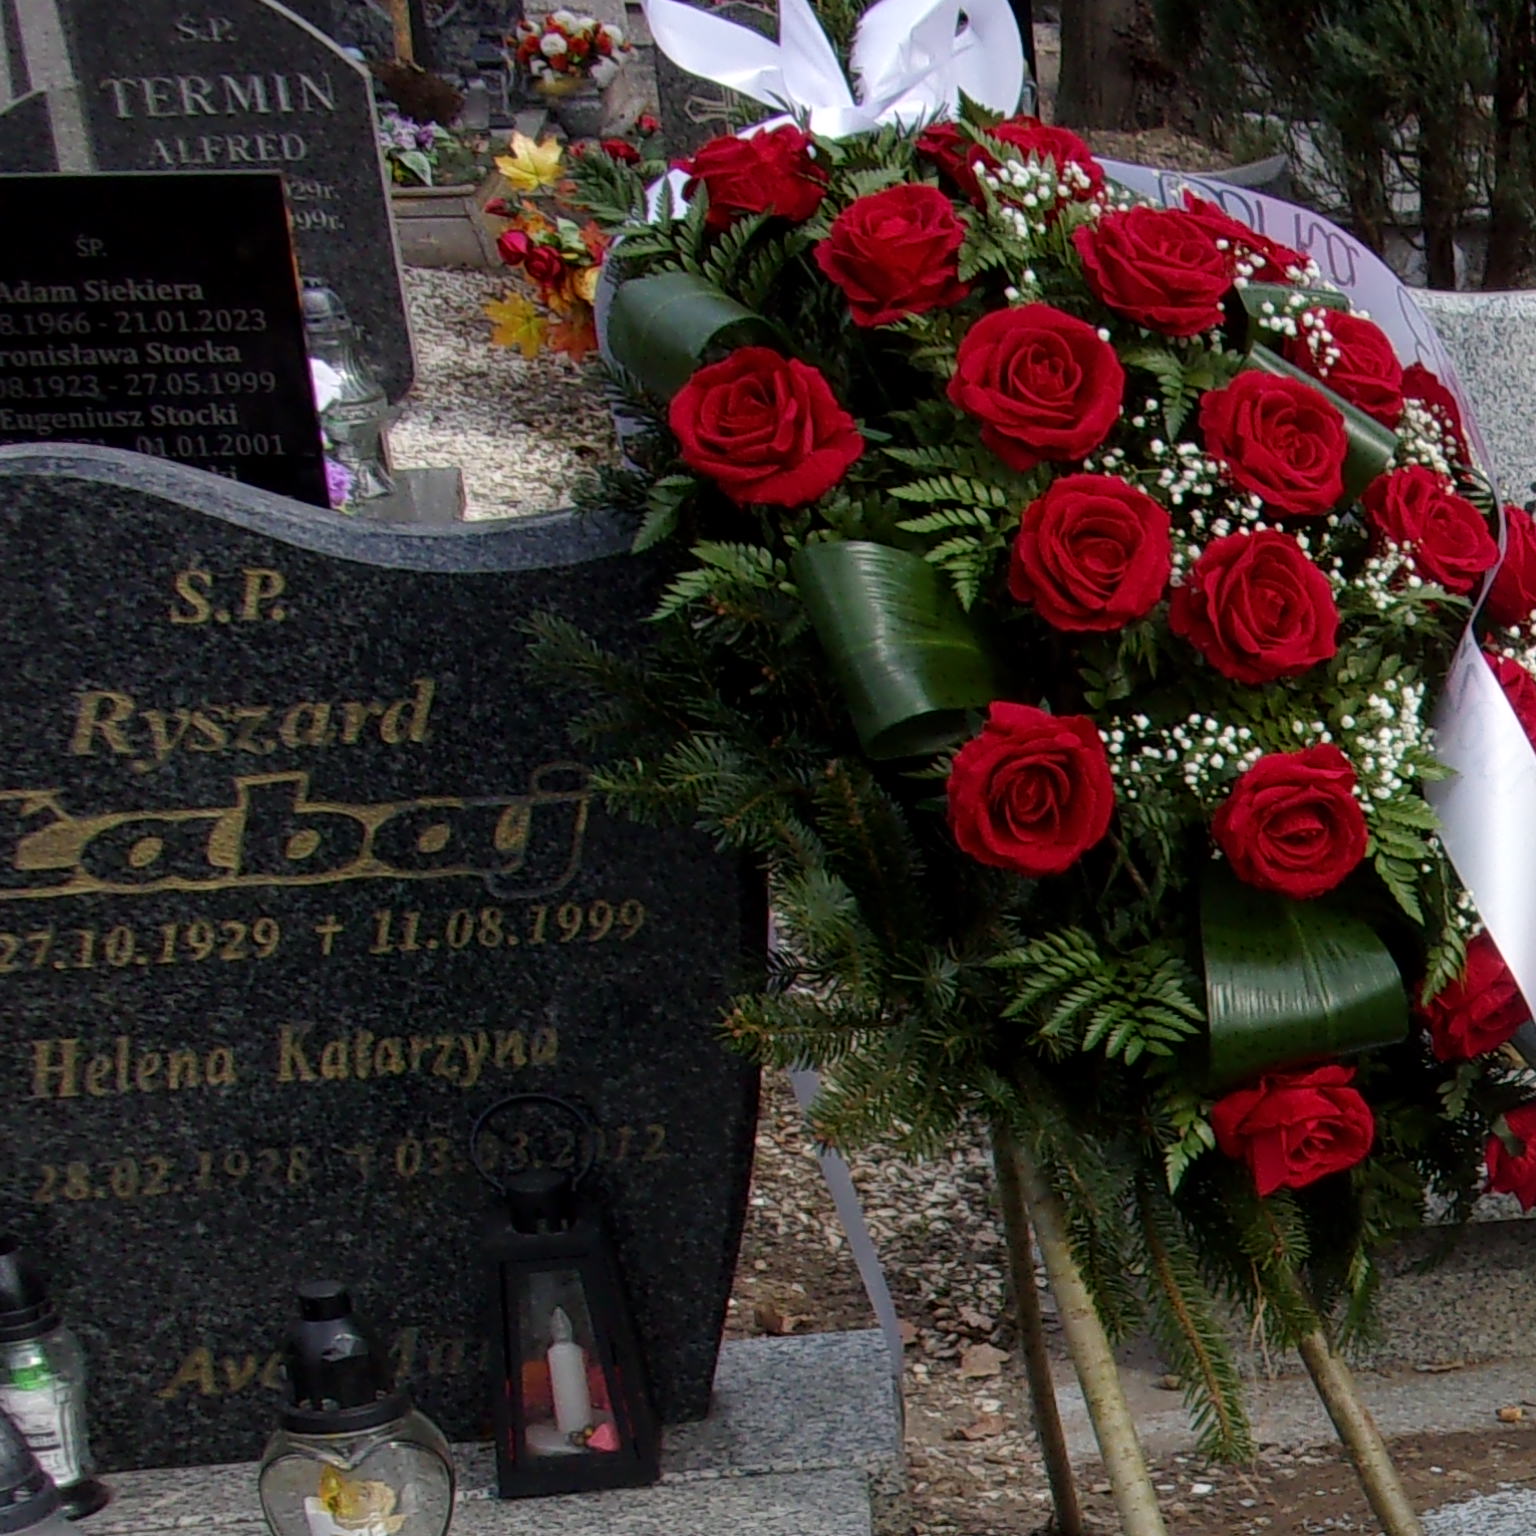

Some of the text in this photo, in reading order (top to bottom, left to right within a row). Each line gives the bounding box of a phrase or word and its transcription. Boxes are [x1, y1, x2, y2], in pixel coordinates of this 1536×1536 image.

[101, 73, 338, 120] TERMIN
[148, 132, 308, 166] ALFRED
[83, 277, 205, 302] Siekiera
[0, 312, 92, 337] 8.1966
[114, 307, 267, 334] 21.01.2023
[0, 340, 242, 369] ronisława Stocka
[124, 370, 277, 398] 27.05.1999
[0, 402, 240, 437] Eugeniusz Stocki
[70, 678, 438, 773] Ryszard
[0, 900, 647, 974] 27.10.1929 11.08.1999
[30, 1022, 560, 1099] Helena Katarzyna
